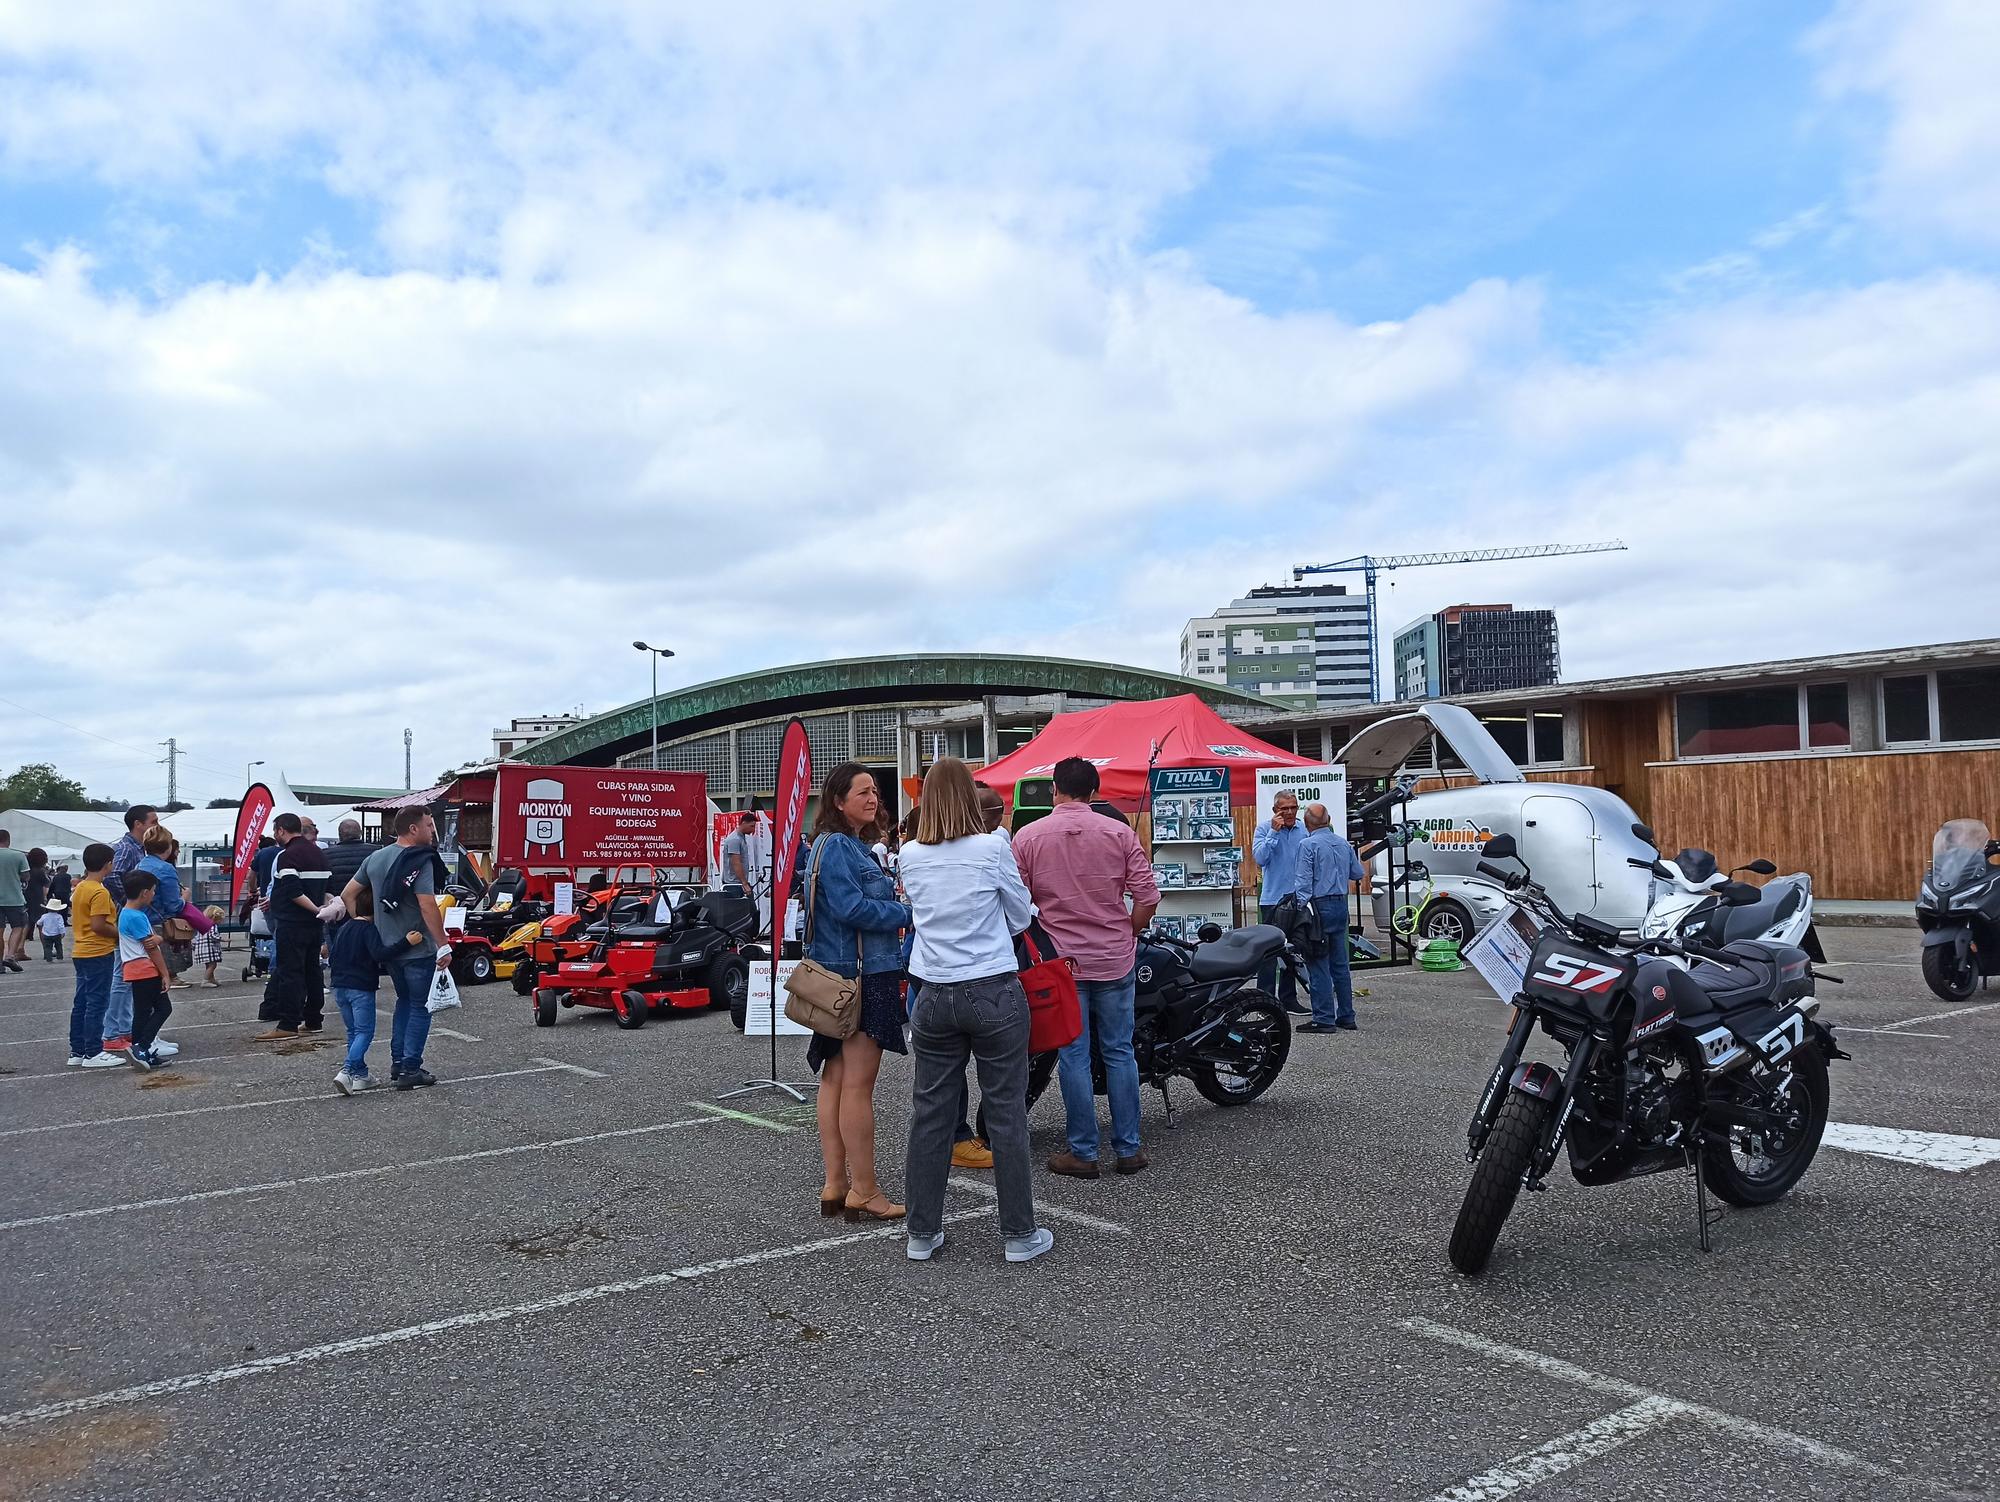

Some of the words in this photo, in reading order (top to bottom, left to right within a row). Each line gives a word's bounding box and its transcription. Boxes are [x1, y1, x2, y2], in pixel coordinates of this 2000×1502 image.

[1166, 771, 1214, 783] TOTAL
[1261, 775, 1279, 785] MDB
[1281, 774, 1307, 784] Green
[1308, 772, 1343, 783] Climber
[597, 781, 626, 790] CUBAS
[628, 782, 650, 791] PARA
[651, 783, 676, 792] SIDRA
[621, 794, 628, 802] Y
[629, 794, 652, 803] VINO
[1298, 787, 1320, 801] 500
[518, 800, 572, 817] MORIYÓN
[589, 806, 659, 817] EQUIPAMIENTOS
[661, 808, 682, 817] PARA
[616, 819, 657, 828] BODEGAS
[1423, 818, 1453, 831] AGRO
[234, 803, 265, 869] anova
[1432, 827, 1475, 843] JARDÍN
[1433, 843, 1484, 851] Valdeso
[582, 850, 599, 858] TLFS.
[600, 850, 613, 858] 985
[613, 850, 623, 858] 89
[623, 850, 633, 858] 06
[633, 850, 642, 858] 95
[646, 850, 660, 858] 676
[660, 850, 668, 858] 13
[669, 850, 677, 858] 57
[678, 850, 687, 858] 89
[754, 967, 771, 975] ROBO
[780, 966, 794, 975] RAD
[1532, 952, 1623, 991] 57
[1636, 1022, 1656, 1038] FLAT
[1755, 1012, 1804, 1064] 57
[1552, 1124, 1563, 1150] FLAT
[1560, 1096, 1575, 1126] TRACK
